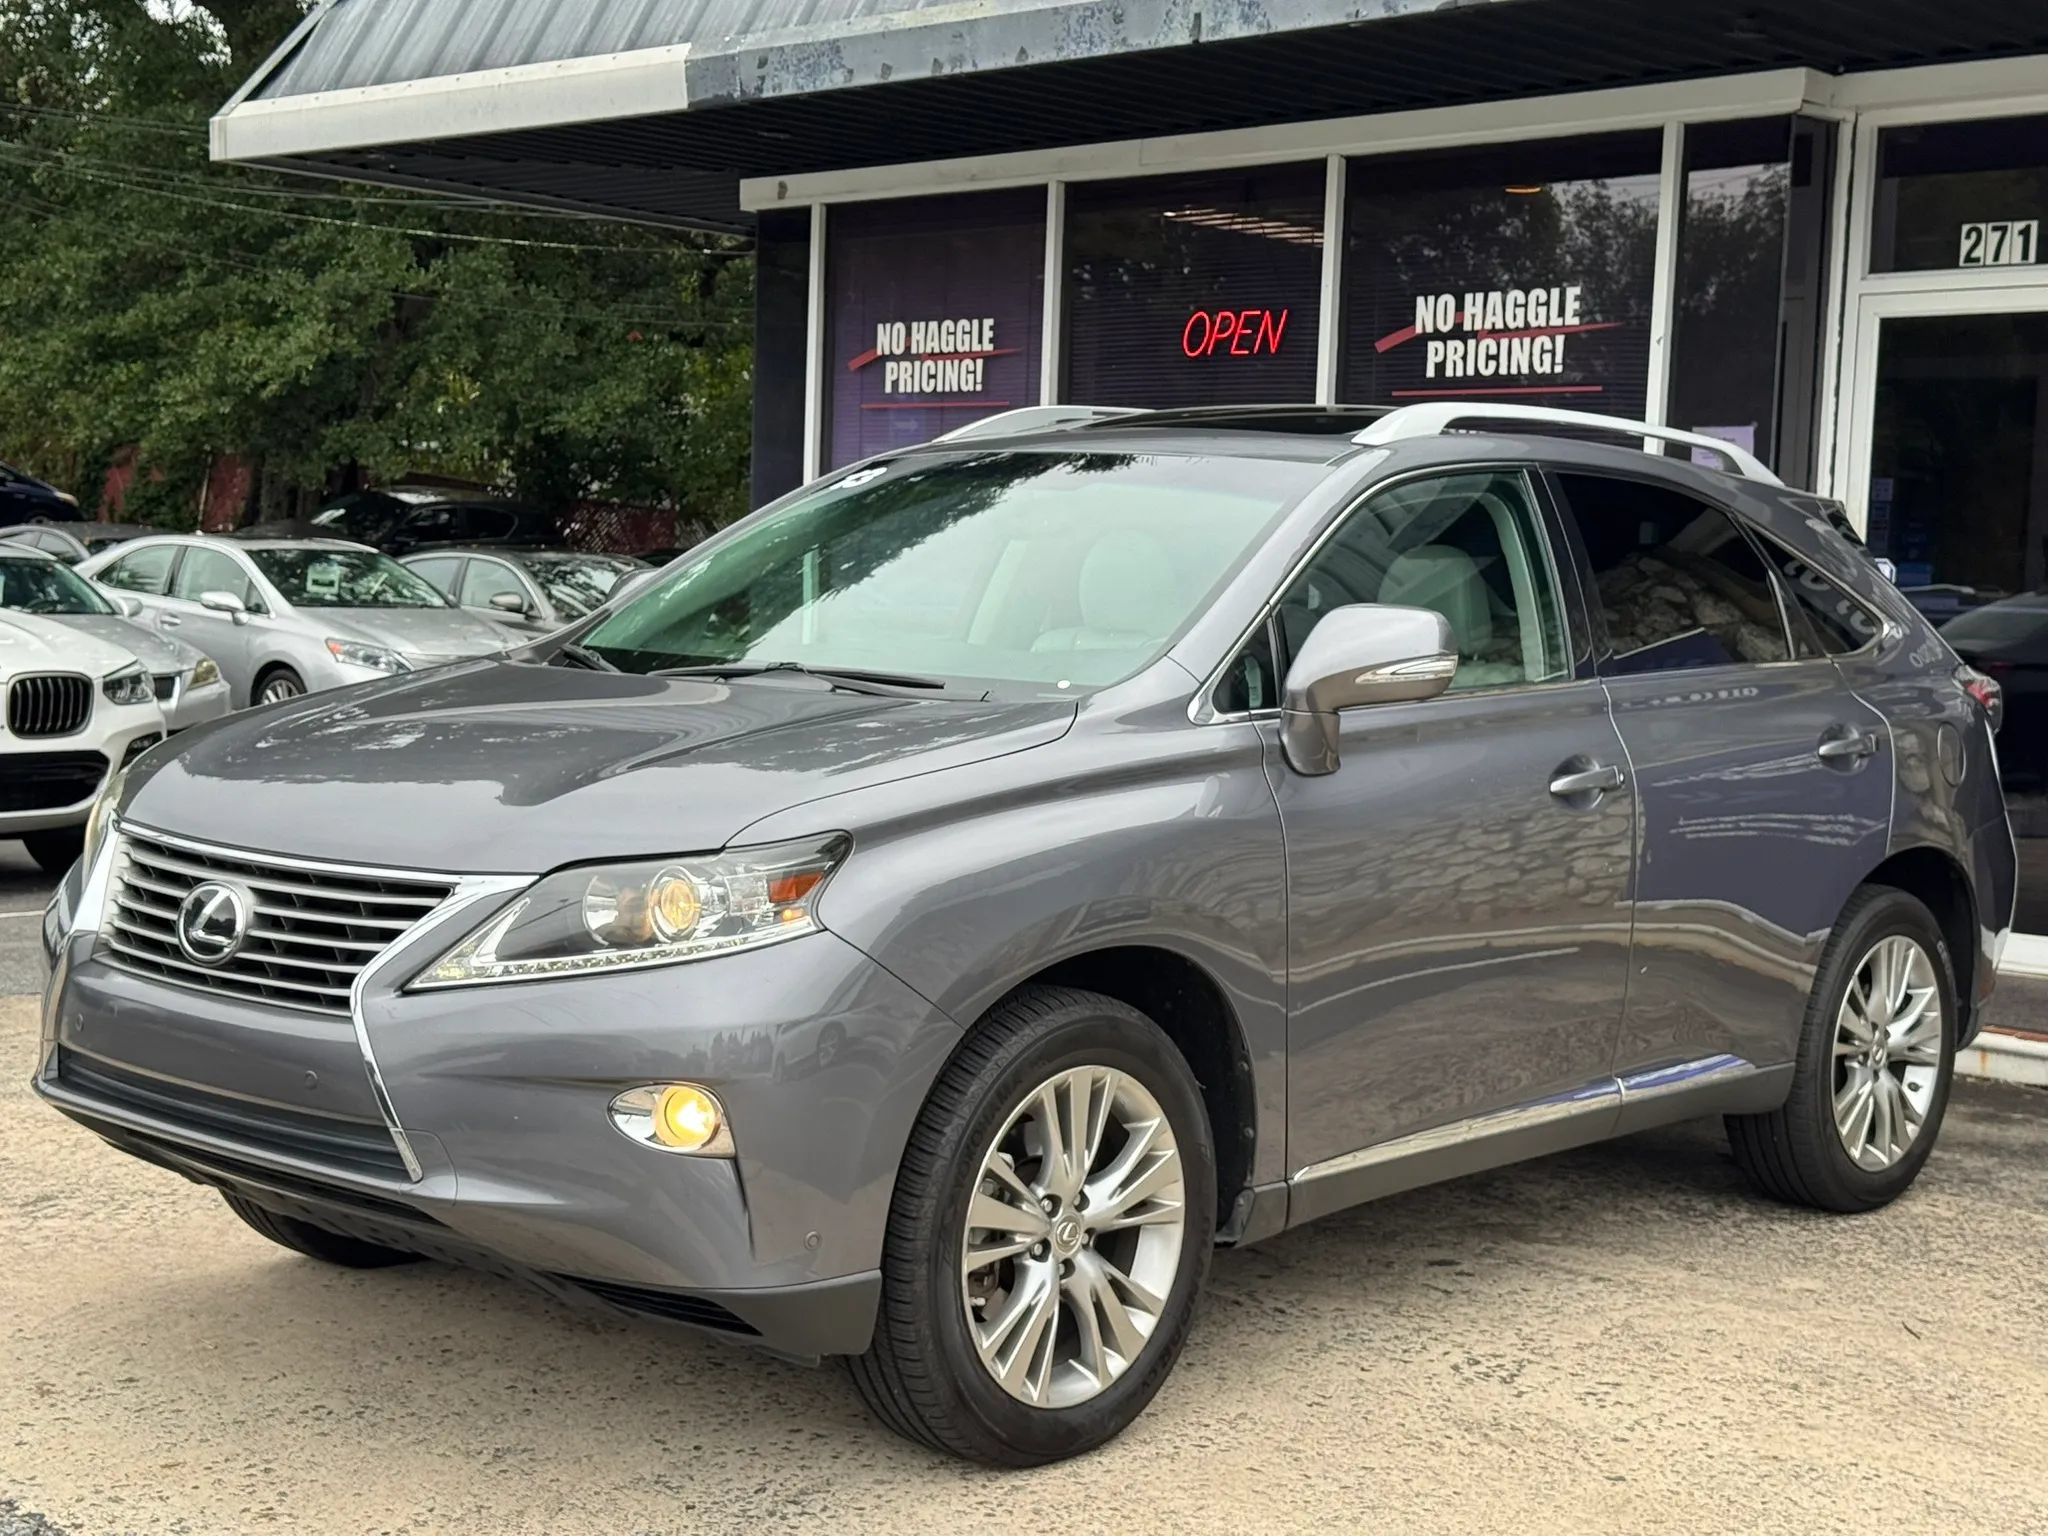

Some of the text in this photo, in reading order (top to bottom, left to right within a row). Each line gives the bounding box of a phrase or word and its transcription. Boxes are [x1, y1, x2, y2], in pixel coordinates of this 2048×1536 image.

[1963, 223, 2031, 264] 271
[1415, 286, 1582, 334] NO HAGGLE
[876, 318, 995, 356] NO HAGGLE
[1183, 309, 1288, 357] OPEN
[884, 358, 984, 394] PRICING!
[1425, 334, 1566, 378] PRICING!
